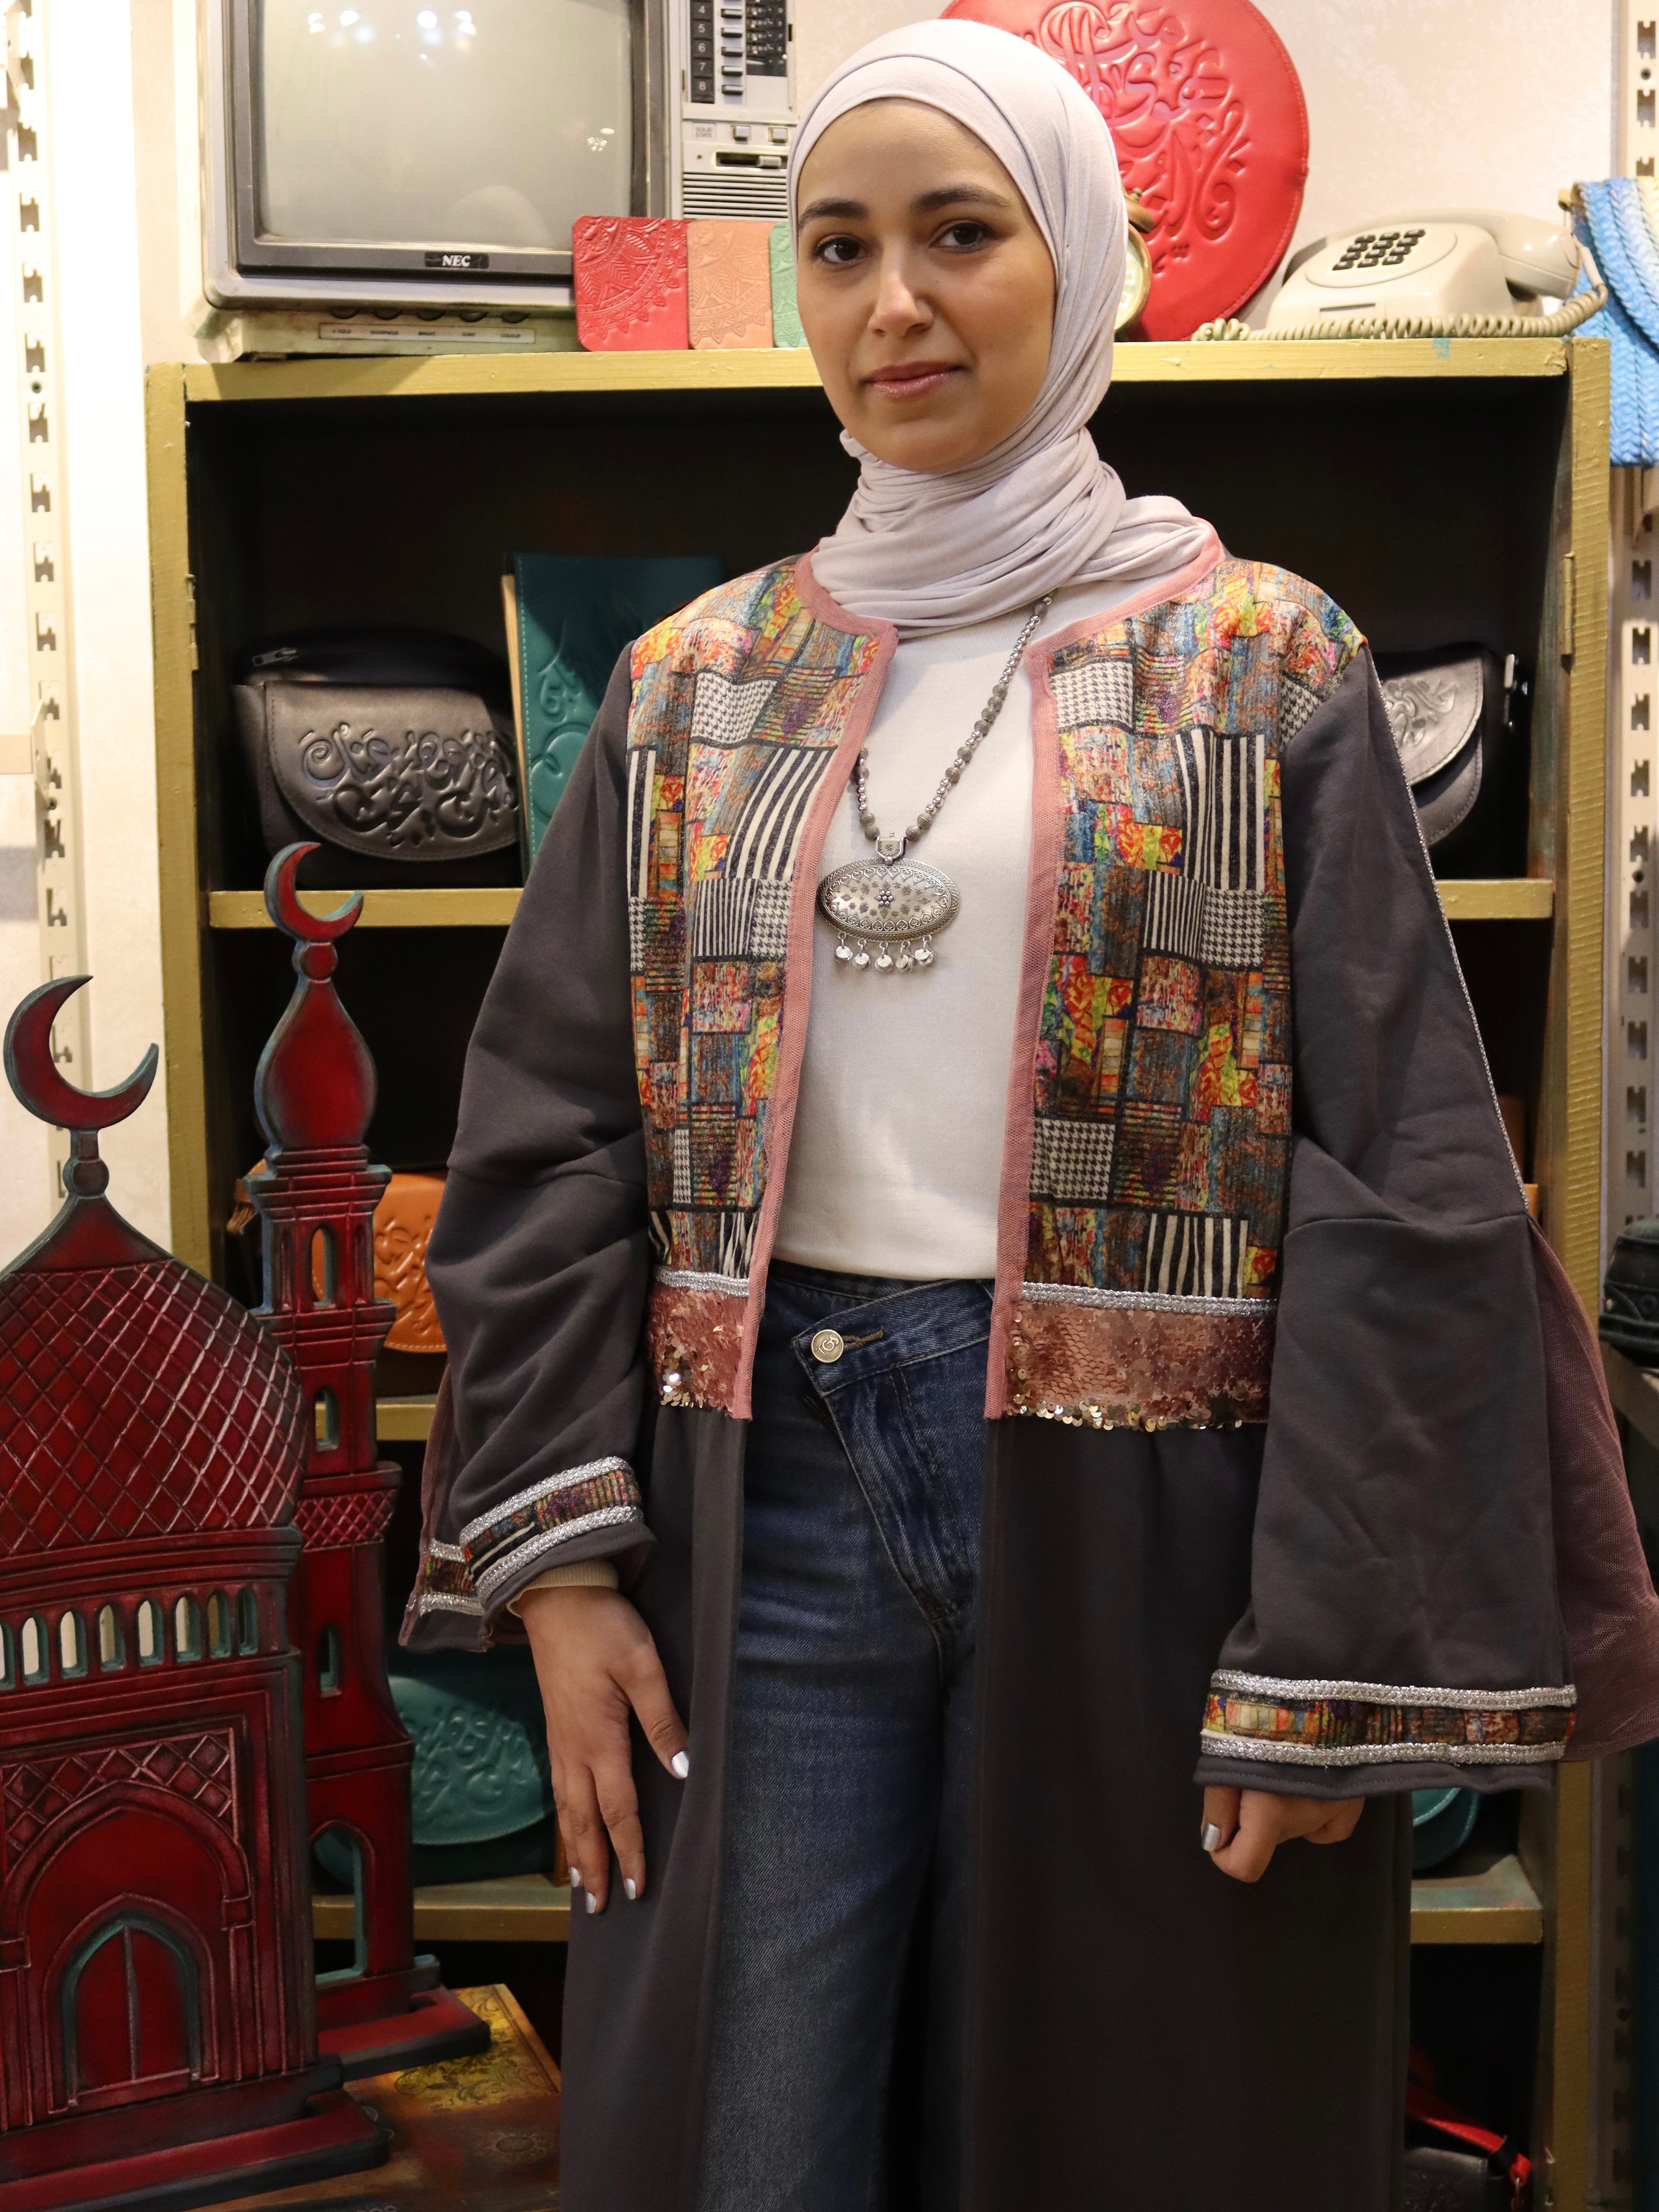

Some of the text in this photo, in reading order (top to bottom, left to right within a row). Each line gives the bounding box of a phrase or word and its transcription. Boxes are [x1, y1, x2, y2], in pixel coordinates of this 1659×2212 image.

[698, 5, 706, 14] 4
[698, 23, 706, 33] 5
[698, 42, 706, 52] 6
[699, 62, 706, 71] 7
[698, 81, 706, 91] 8
[442, 254, 471, 267] NEC
